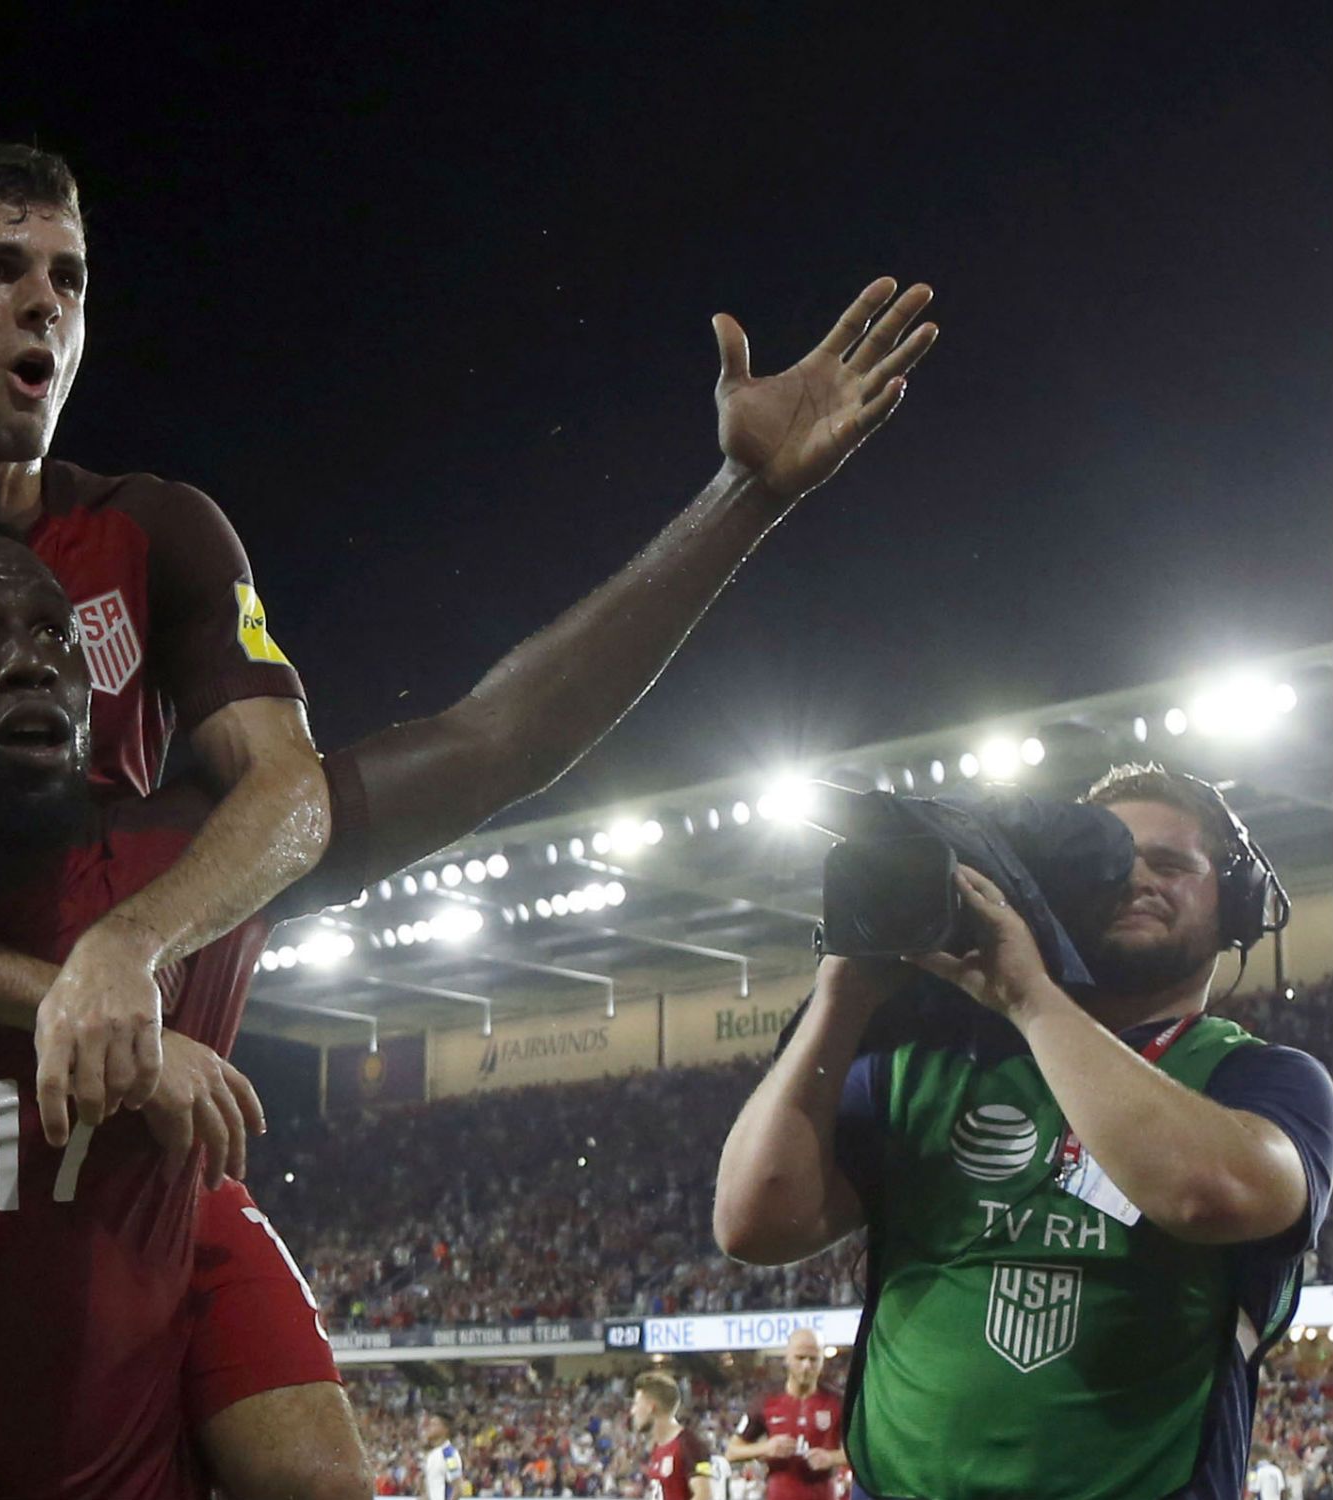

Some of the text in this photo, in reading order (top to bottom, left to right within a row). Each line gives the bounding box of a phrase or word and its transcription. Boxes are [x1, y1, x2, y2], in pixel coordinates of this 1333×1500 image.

[78, 597, 123, 642] SA
[716, 1005, 795, 1040] Heine
[501, 1025, 610, 1062] FAIRWINDS
[977, 1199, 1107, 1250] TV RH
[998, 1267, 1075, 1310] USA
[433, 1329, 457, 1346] ONE
[508, 1325, 533, 1344] ONE
